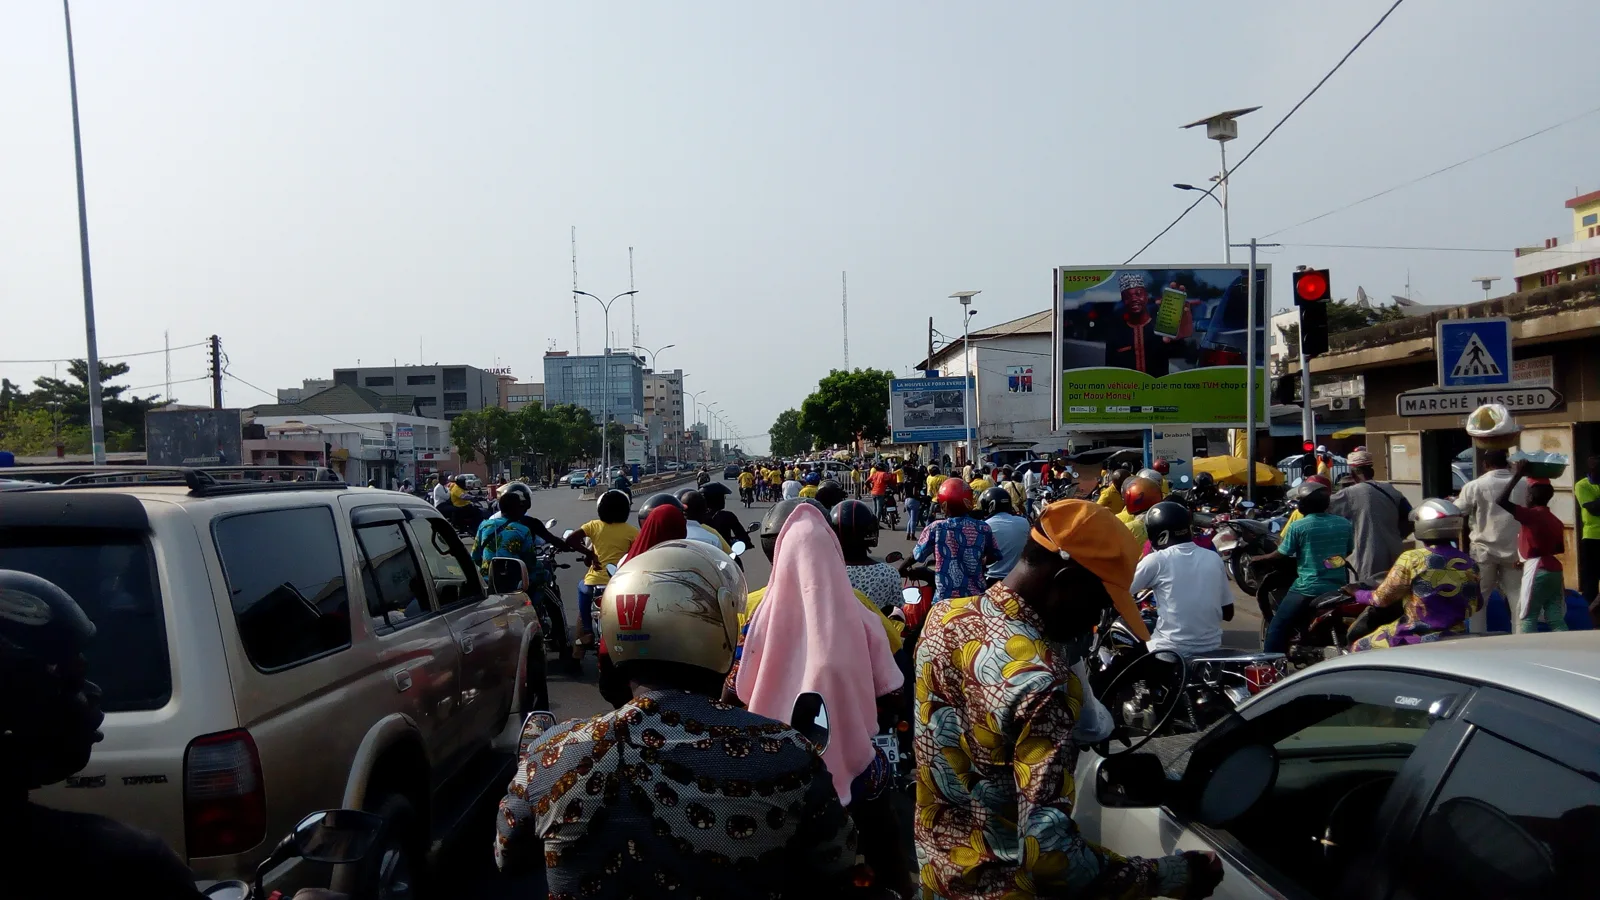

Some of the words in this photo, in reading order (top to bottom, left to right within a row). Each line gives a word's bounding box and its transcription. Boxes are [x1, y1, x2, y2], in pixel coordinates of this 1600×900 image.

[1069, 382, 1087, 390] Pour
[1151, 382, 1168, 391] paie
[1069, 393, 1082, 401] par
[1083, 392, 1105, 400] Moov
[1106, 392, 1131, 401] Money
[1405, 395, 1469, 411] MARCHÉ
[1477, 393, 1546, 407] MISSEBO
[1394, 695, 1423, 706] CAMRY
[121, 774, 168, 785] TOYOTA
